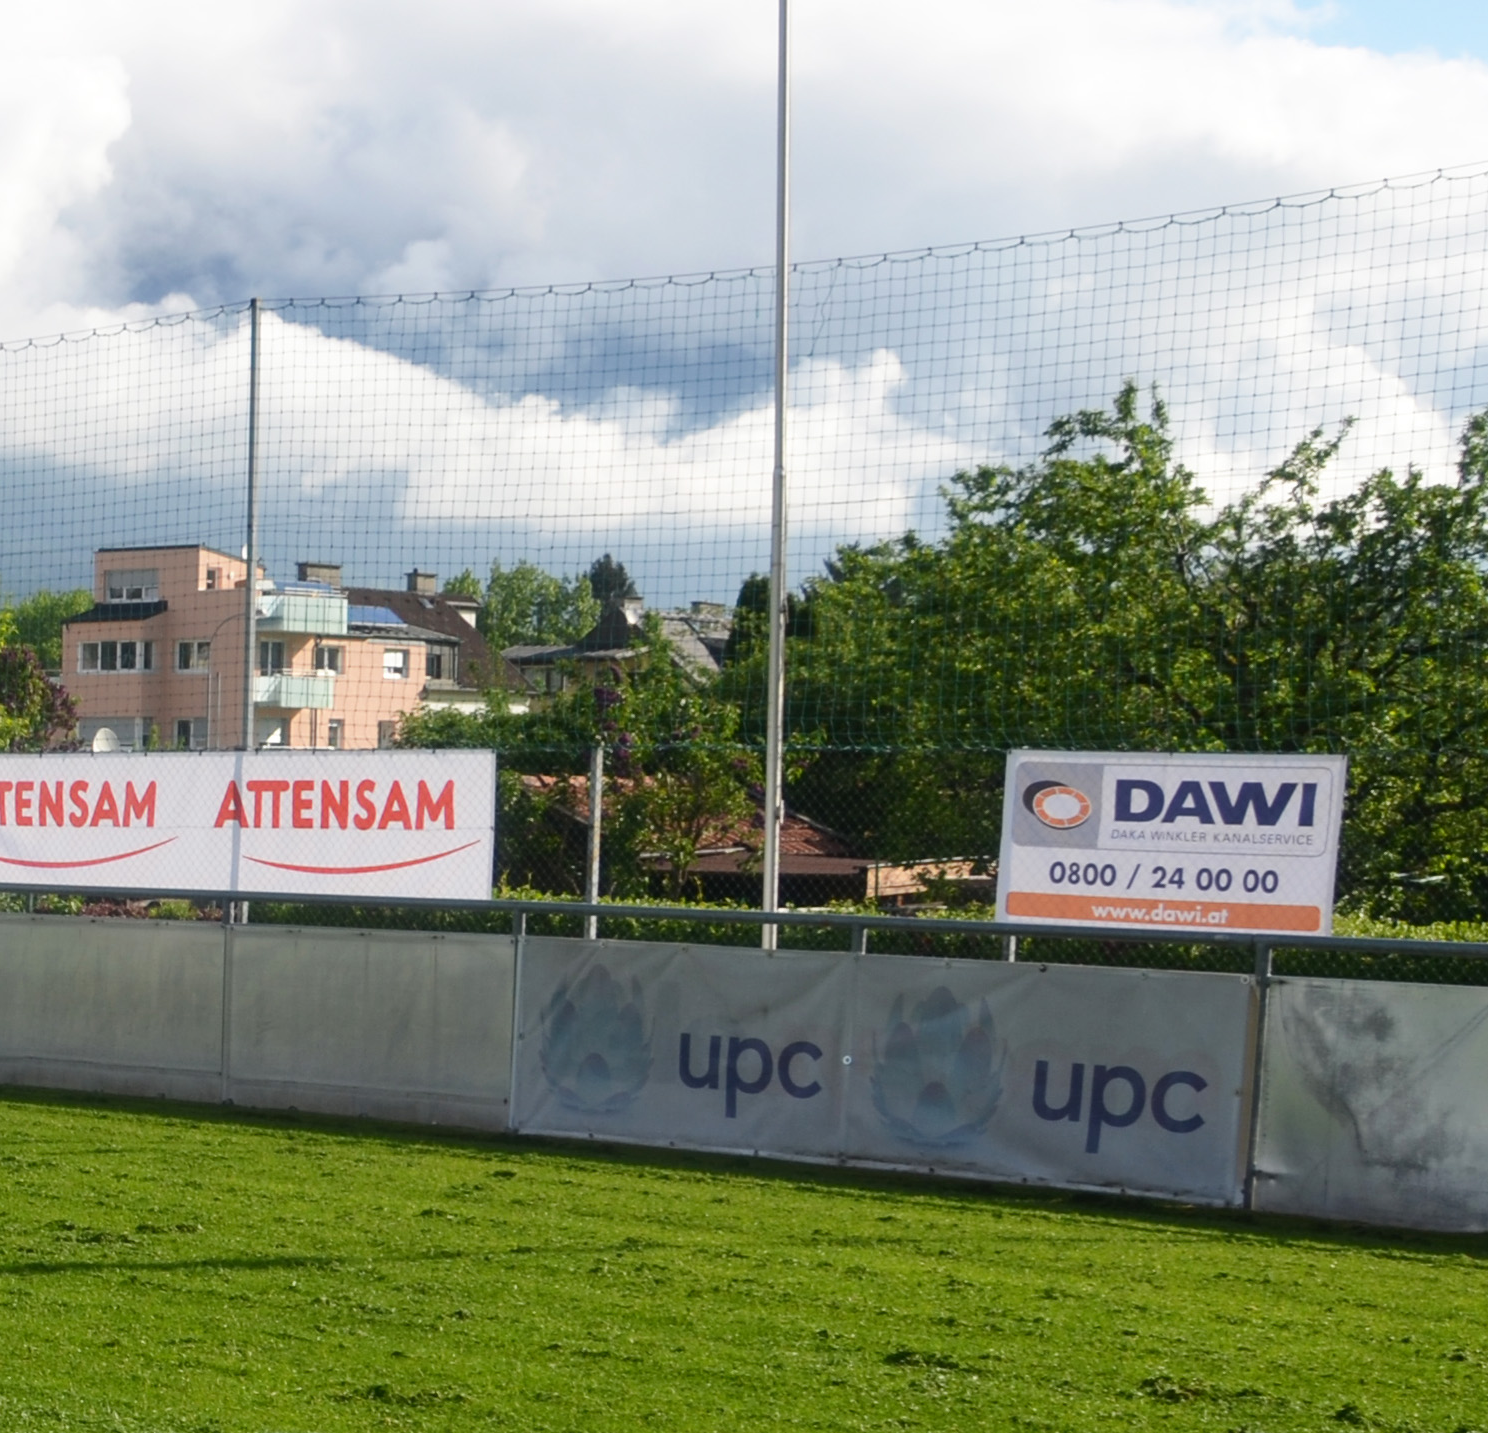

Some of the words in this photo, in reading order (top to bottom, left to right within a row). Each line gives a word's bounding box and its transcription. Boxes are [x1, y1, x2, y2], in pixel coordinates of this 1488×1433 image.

[213, 780, 455, 830] ATTENSAM
[1114, 779, 1318, 827] DAWI
[1111, 829, 1146, 841] DAKA
[1213, 832, 1313, 845] KANALSERVICE
[1049, 861, 1117, 886] 0800
[1126, 863, 1141, 889] /
[1151, 866, 1185, 890] 24
[1195, 868, 1233, 891] 00
[1242, 870, 1279, 893] 00
[1091, 903, 1229, 924] www.dawi.at
[679, 1033, 823, 1119] upc
[1032, 1060, 1208, 1154] upc
